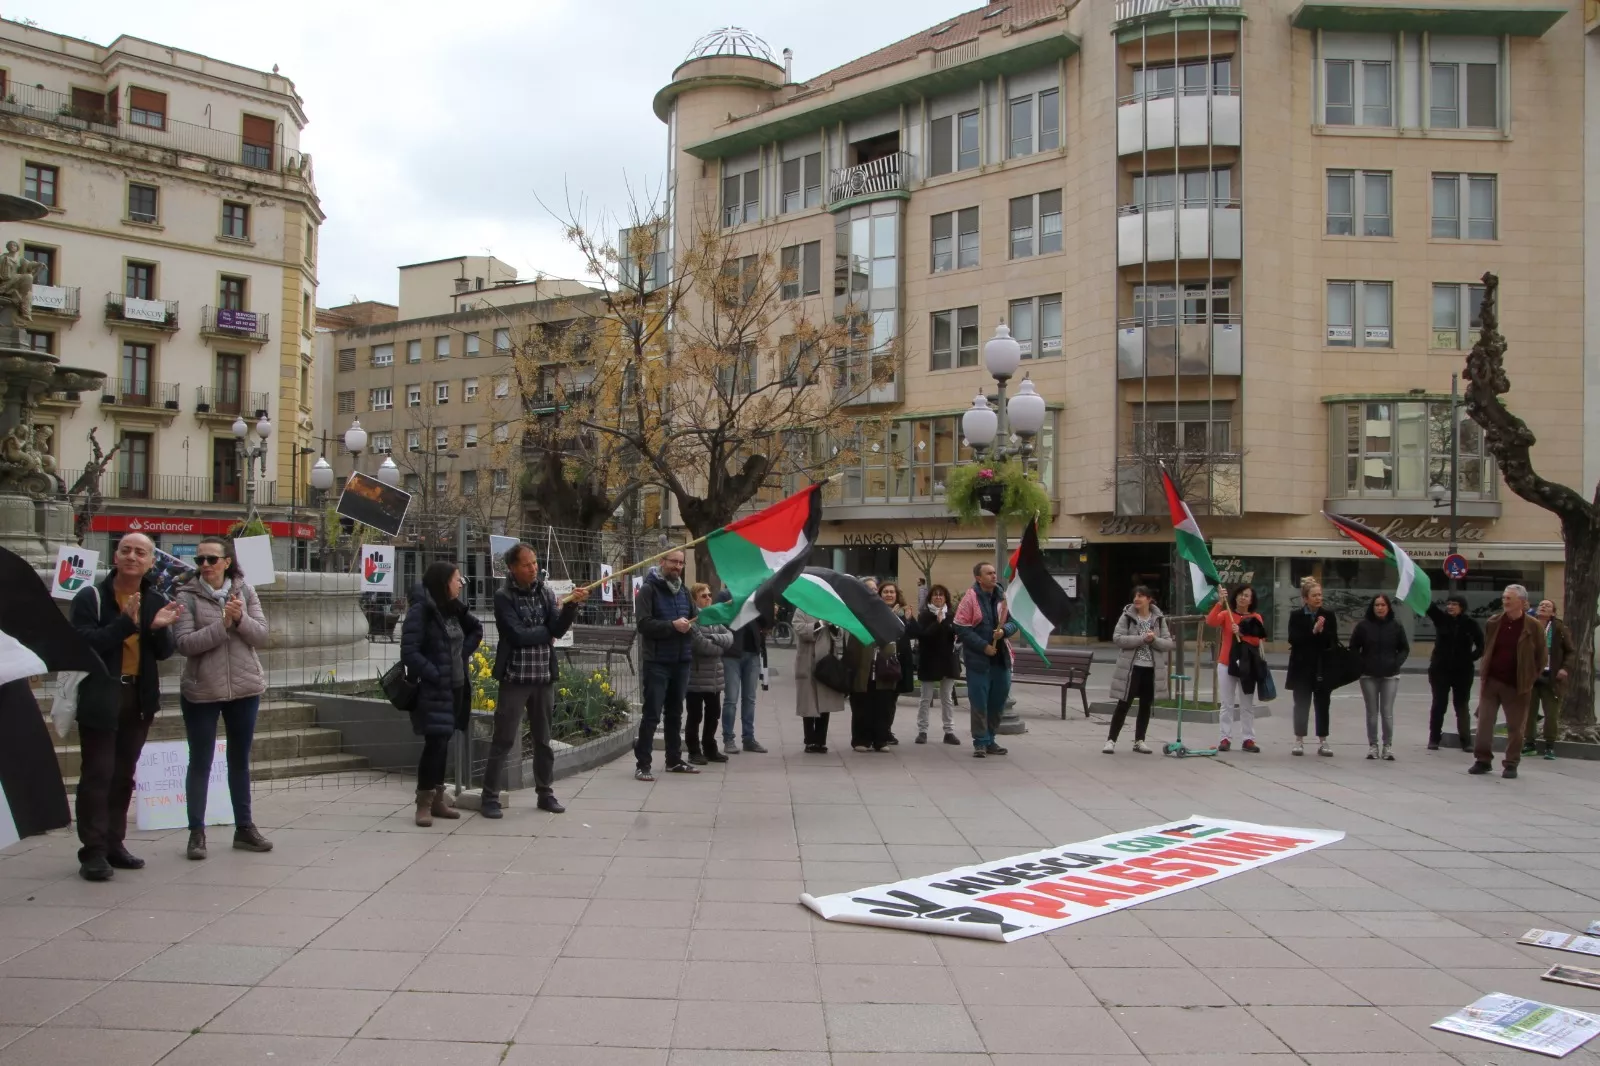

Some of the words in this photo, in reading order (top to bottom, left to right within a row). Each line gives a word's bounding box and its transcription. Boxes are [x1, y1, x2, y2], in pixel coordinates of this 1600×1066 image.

[143, 521, 193, 532] Santander
[1099, 516, 1161, 536] Bar
[843, 533, 894, 545] MANGO
[929, 852, 1117, 895] HUESCA
[1102, 834, 1180, 853] CON
[974, 831, 1316, 919] PALESTINA
